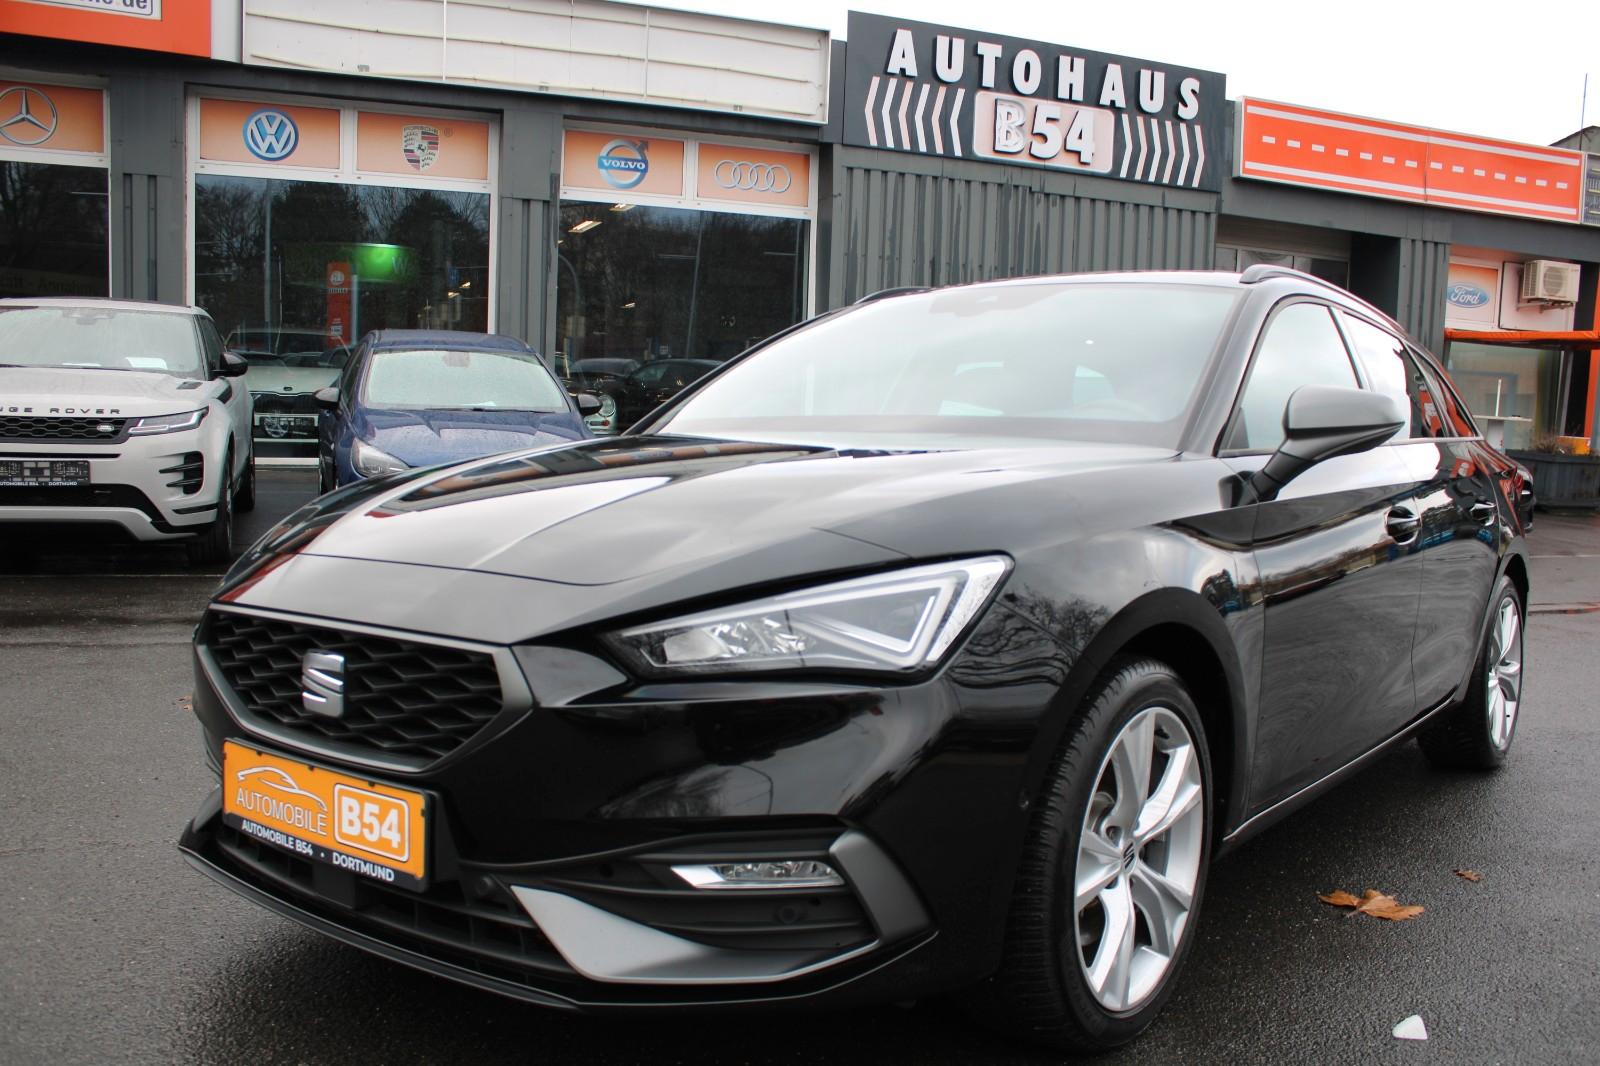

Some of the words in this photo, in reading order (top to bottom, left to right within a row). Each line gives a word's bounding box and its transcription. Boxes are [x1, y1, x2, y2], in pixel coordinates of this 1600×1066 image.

[887, 28, 1201, 120] AUTOHAUS
[994, 98, 1095, 165] B54
[602, 159, 646, 170] VOLVO
[1450, 286, 1480, 304] Ford
[49, 407, 120, 415] ROVER
[236, 787, 328, 836] AUTOMOBILE
[341, 795, 401, 849] B54
[242, 819, 295, 849] AUTOMOBILE
[295, 839, 314, 857] B54
[332, 851, 395, 882] DORTMUND
